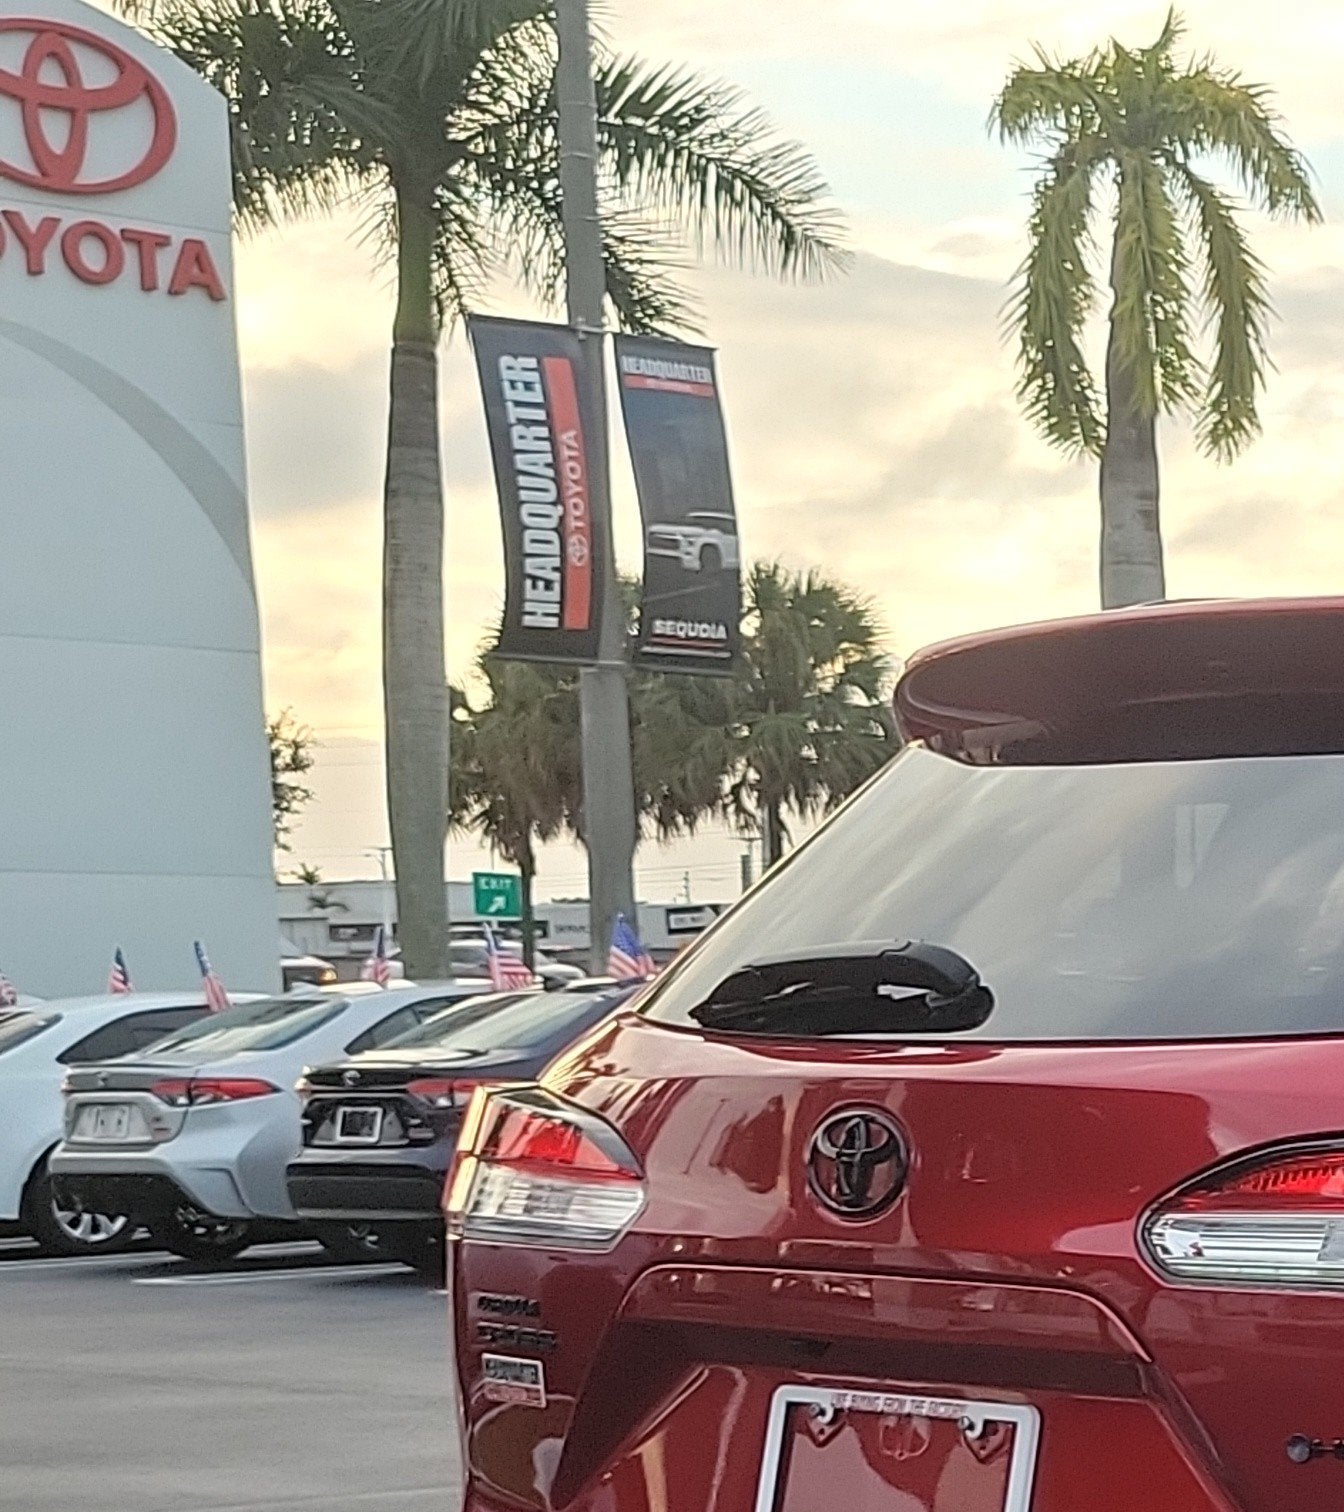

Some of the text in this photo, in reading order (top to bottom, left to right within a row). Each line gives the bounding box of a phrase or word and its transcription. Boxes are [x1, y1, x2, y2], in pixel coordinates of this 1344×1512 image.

[0, 209, 227, 301] YOTA
[499, 354, 564, 629] HEADQUARTER
[560, 430, 587, 534] TOYOTA
[653, 619, 728, 640] SEQUOIA
[478, 877, 513, 890] EXIT
